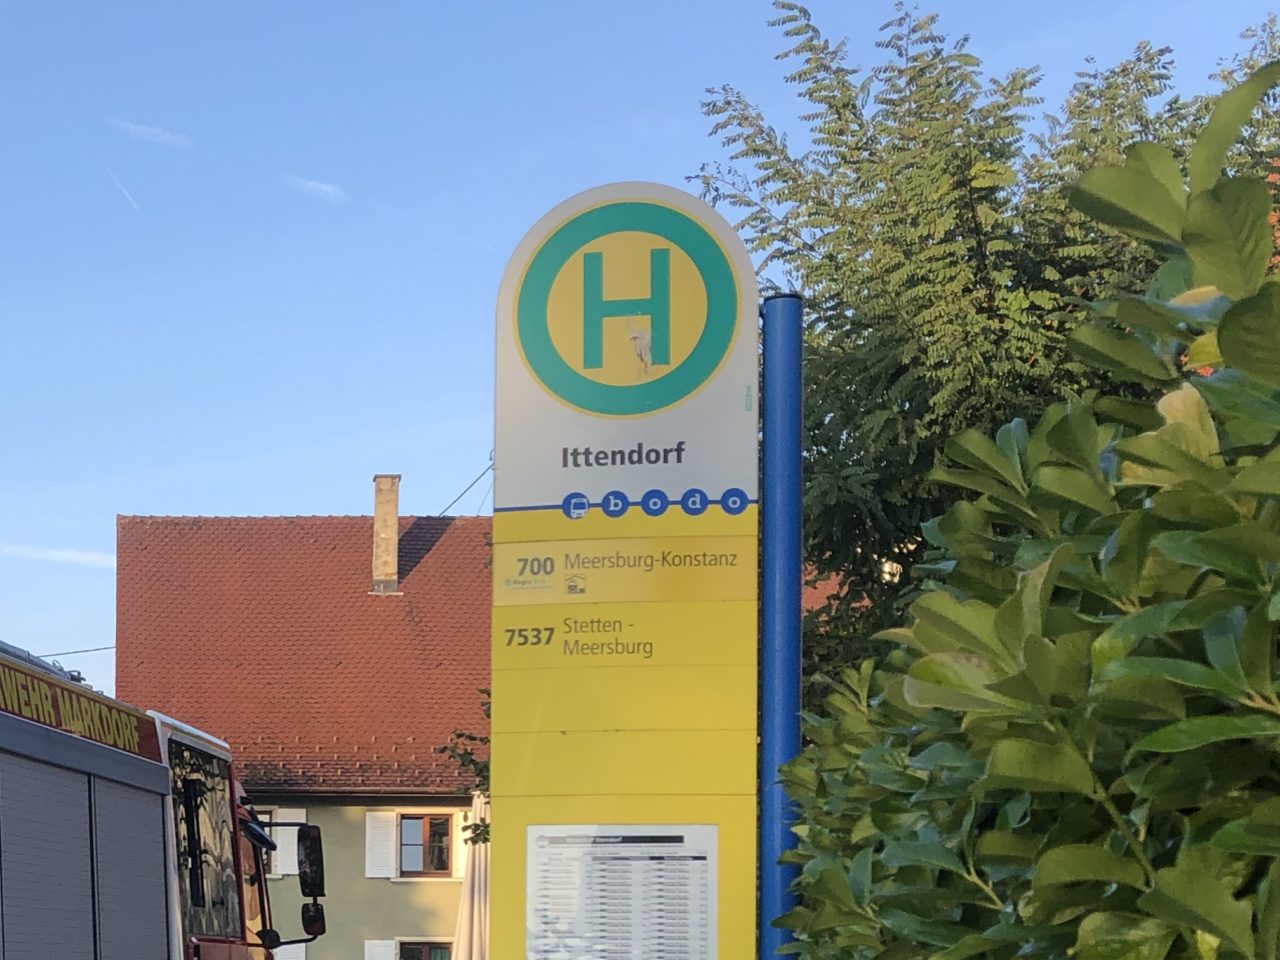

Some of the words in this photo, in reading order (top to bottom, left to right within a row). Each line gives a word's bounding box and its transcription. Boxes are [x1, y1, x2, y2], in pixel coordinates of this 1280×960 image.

[583, 248, 670, 369] H
[562, 441, 686, 468] Ittendorf
[517, 557, 555, 576] 700
[564, 551, 738, 572] Meersburg-Konstanz
[505, 628, 555, 646] 7537
[563, 618, 622, 634] Stetten
[563, 638, 654, 658] Meersburg
[56, 687, 140, 753] MARKDORF
